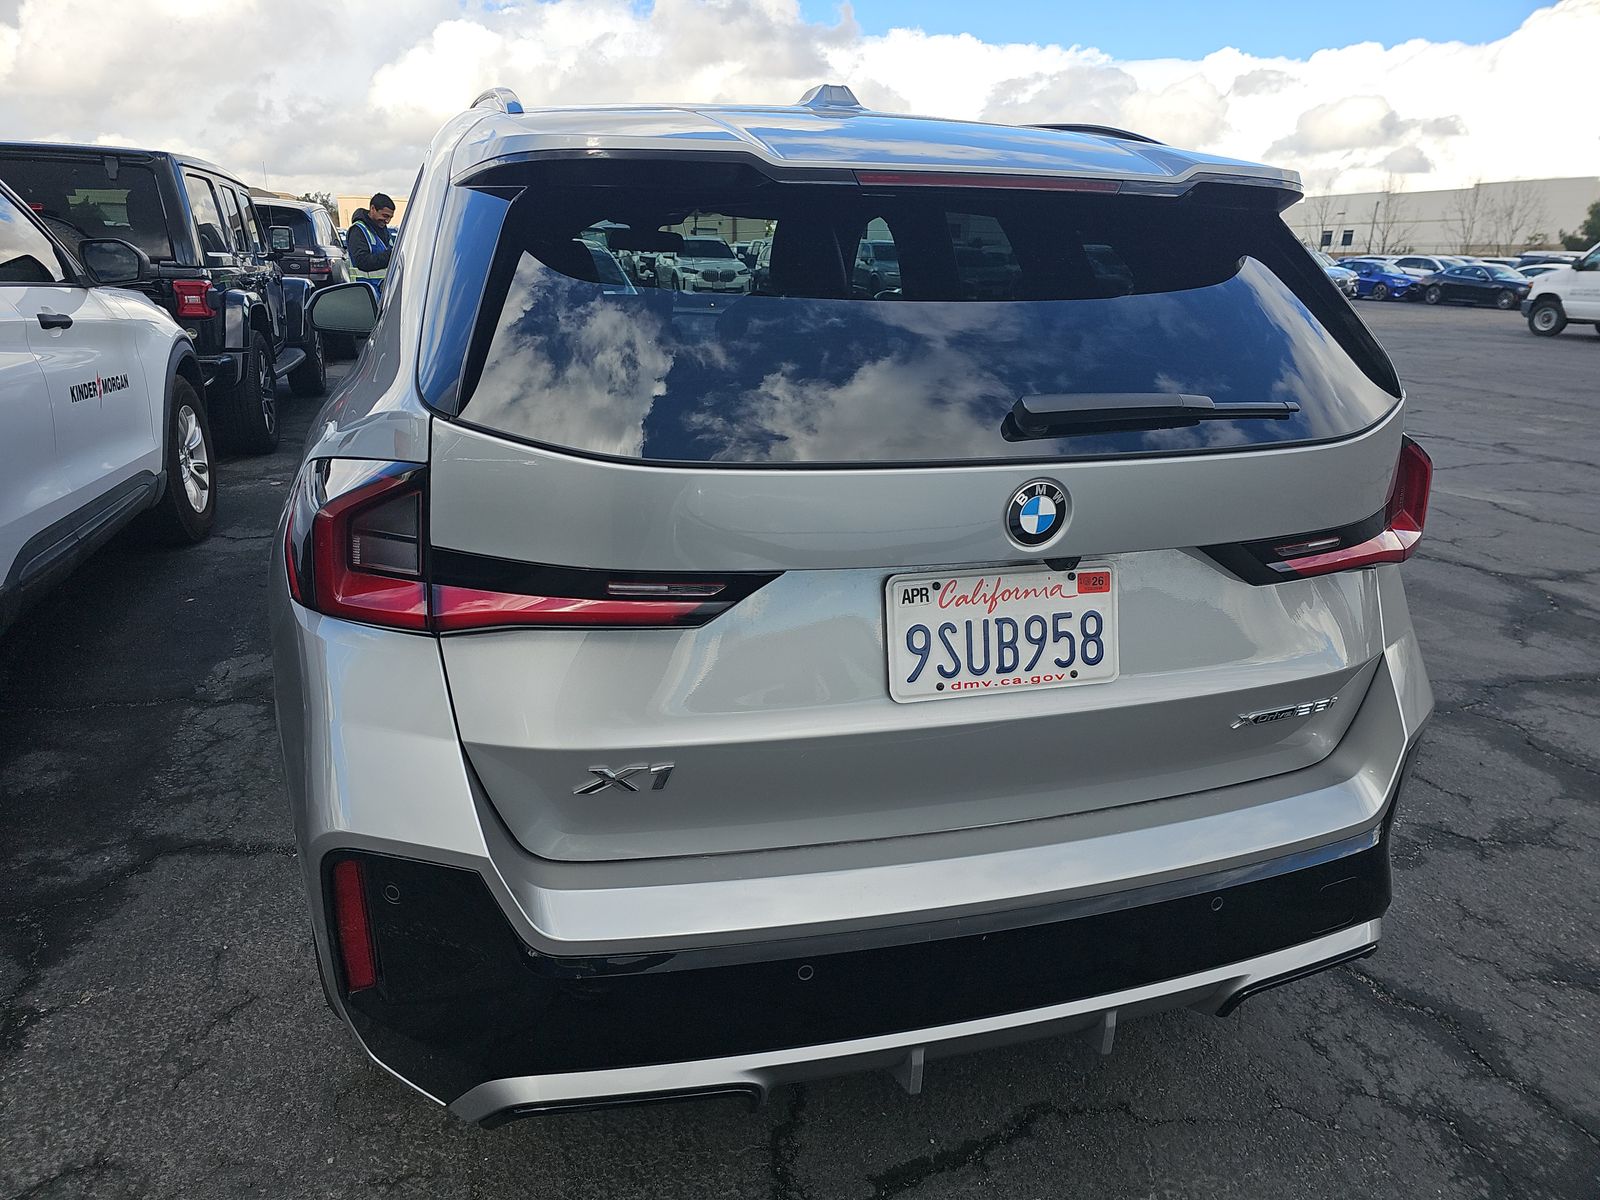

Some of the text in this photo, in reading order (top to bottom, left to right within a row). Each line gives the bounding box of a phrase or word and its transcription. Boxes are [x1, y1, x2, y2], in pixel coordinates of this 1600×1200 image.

[69, 373, 130, 403] KINDER MORGAN
[1015, 484, 1064, 506] BMW
[1092, 576, 1104, 586] 26
[902, 587, 929, 605] APR
[938, 576, 1078, 614] California
[906, 610, 1104, 683] 9SUB958
[951, 672, 1065, 690] dmv.ca.gov
[573, 762, 675, 795] X1
